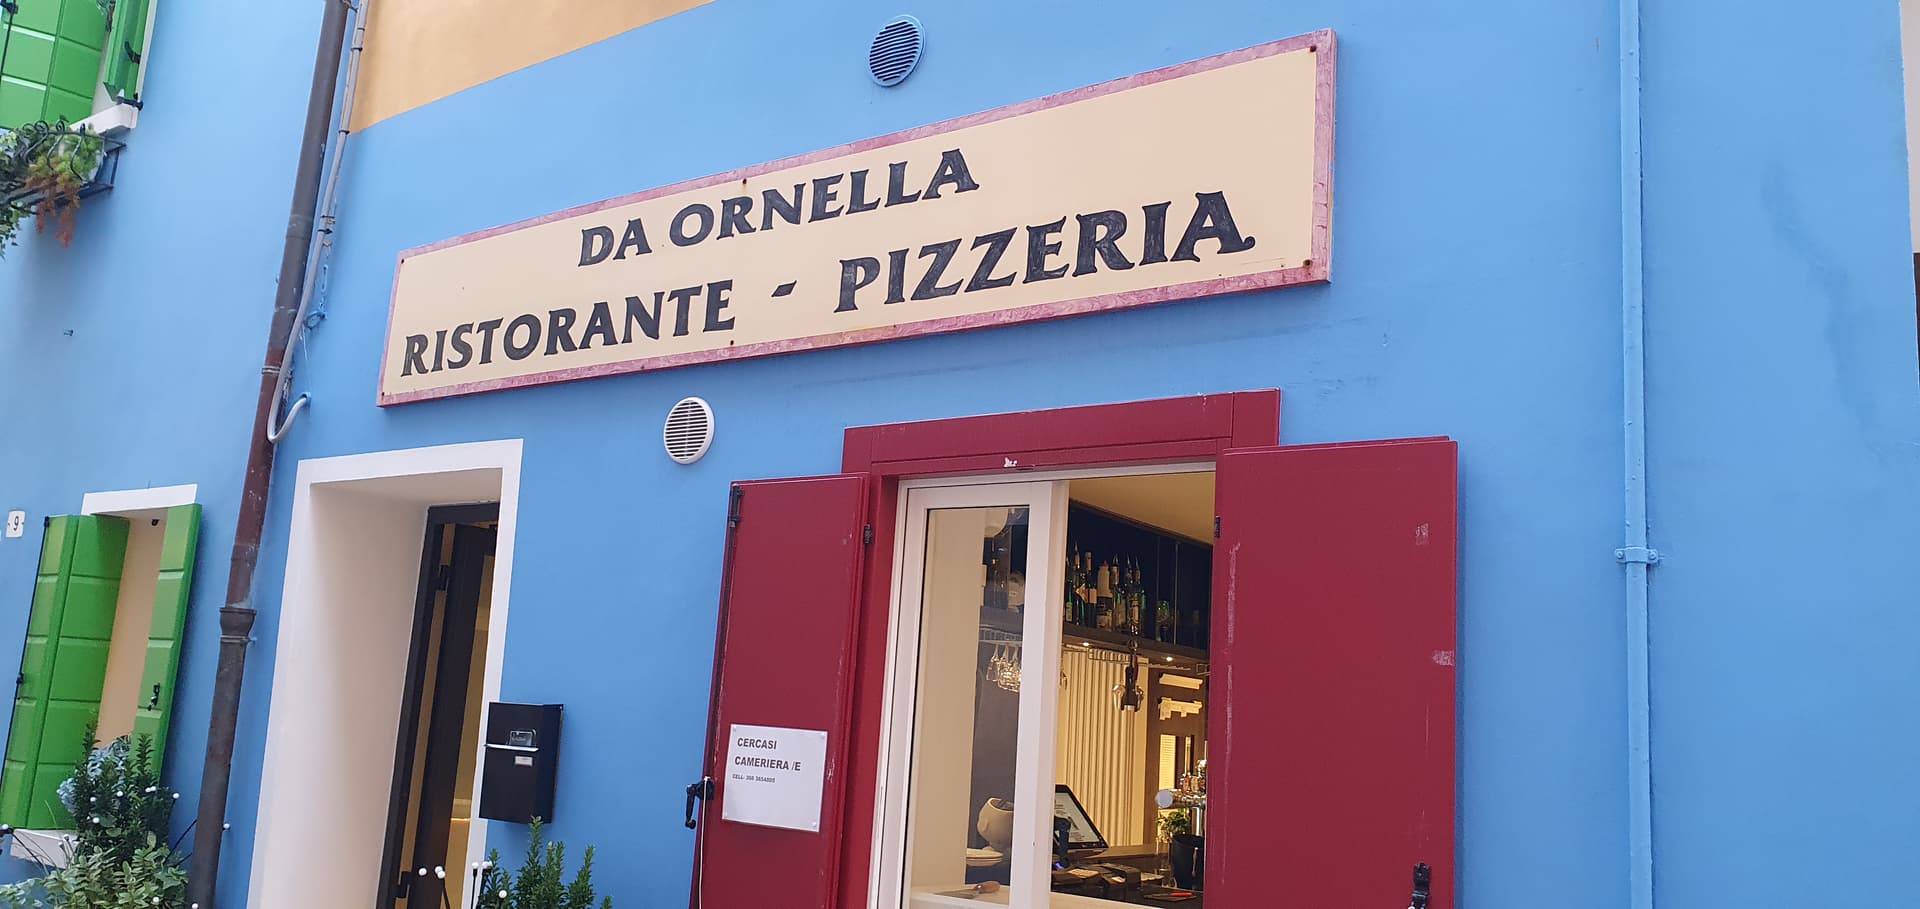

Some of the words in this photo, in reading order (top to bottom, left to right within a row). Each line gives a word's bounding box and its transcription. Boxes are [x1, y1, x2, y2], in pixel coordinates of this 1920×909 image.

[578, 218, 653, 267] DA
[669, 149, 980, 247] ORNELLA
[400, 279, 736, 378] RISTORANTE
[772, 280, 798, 298] -
[834, 190, 1256, 314] PIZZERIA
[13, 515, 20, 531] 9
[737, 737, 777, 750] CERCASI
[734, 756, 789, 770] CAMERIERA
